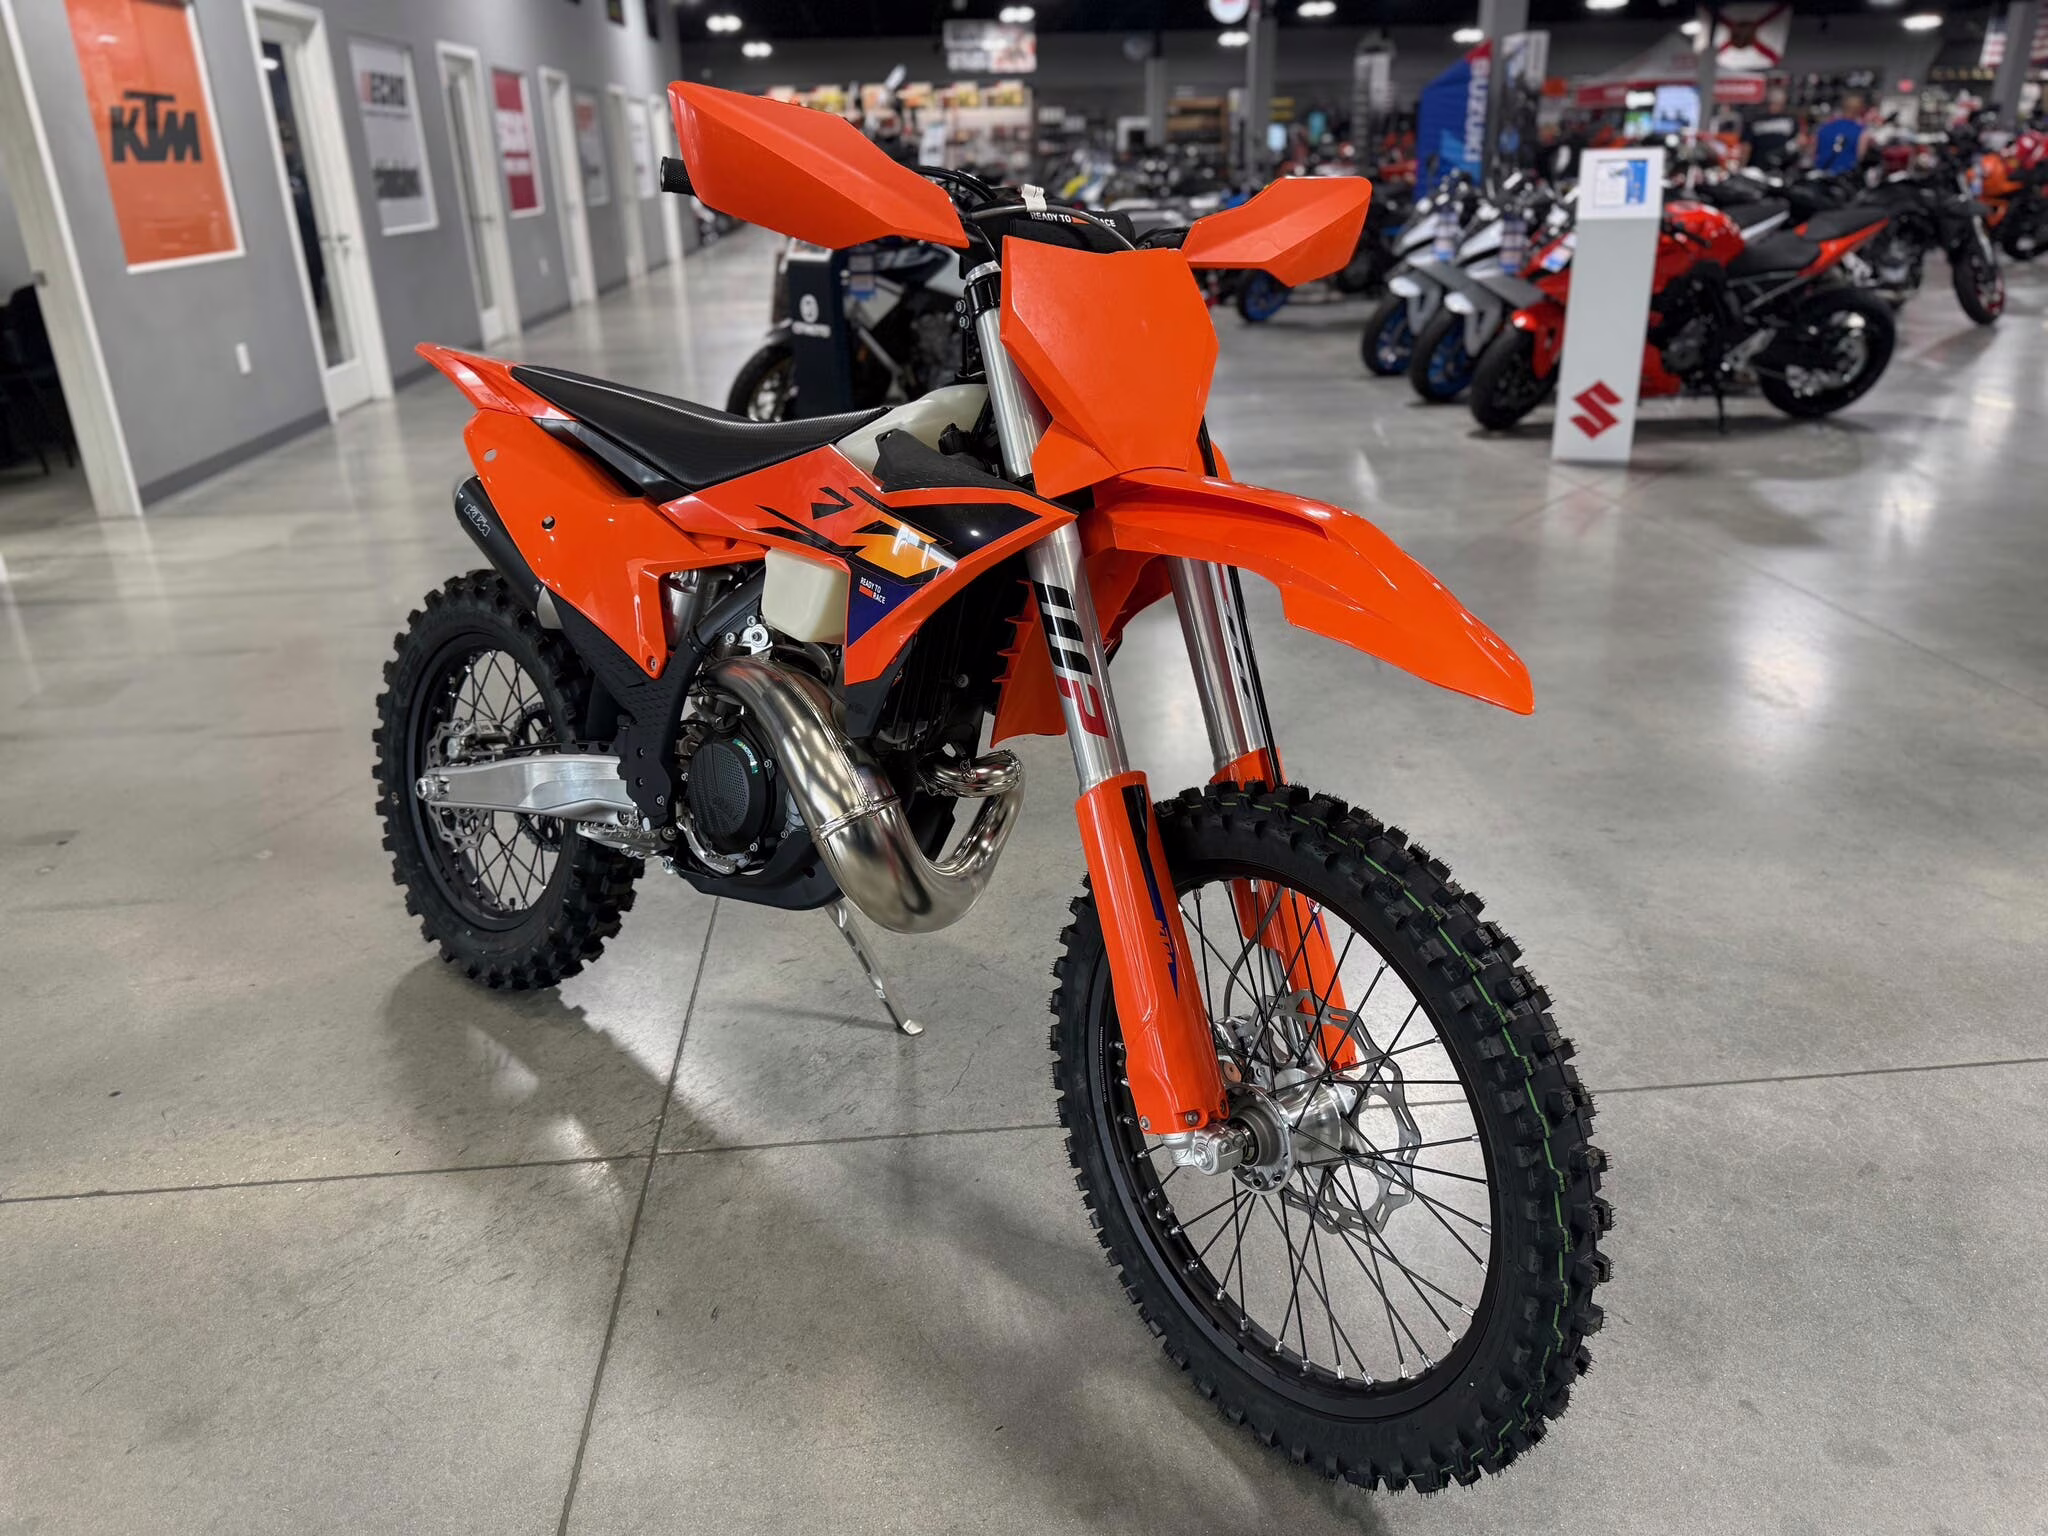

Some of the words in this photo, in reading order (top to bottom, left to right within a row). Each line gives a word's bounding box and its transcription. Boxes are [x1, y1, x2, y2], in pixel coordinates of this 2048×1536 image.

[1464, 57, 1490, 162] SUZUKI
[110, 90, 203, 163] KTM
[1030, 211, 1058, 222] READY
[1059, 213, 1072, 223] TO
[464, 503, 491, 537] KTM
[860, 577, 875, 589] READY
[875, 584, 882, 594] TO
[873, 592, 885, 604] RACE
